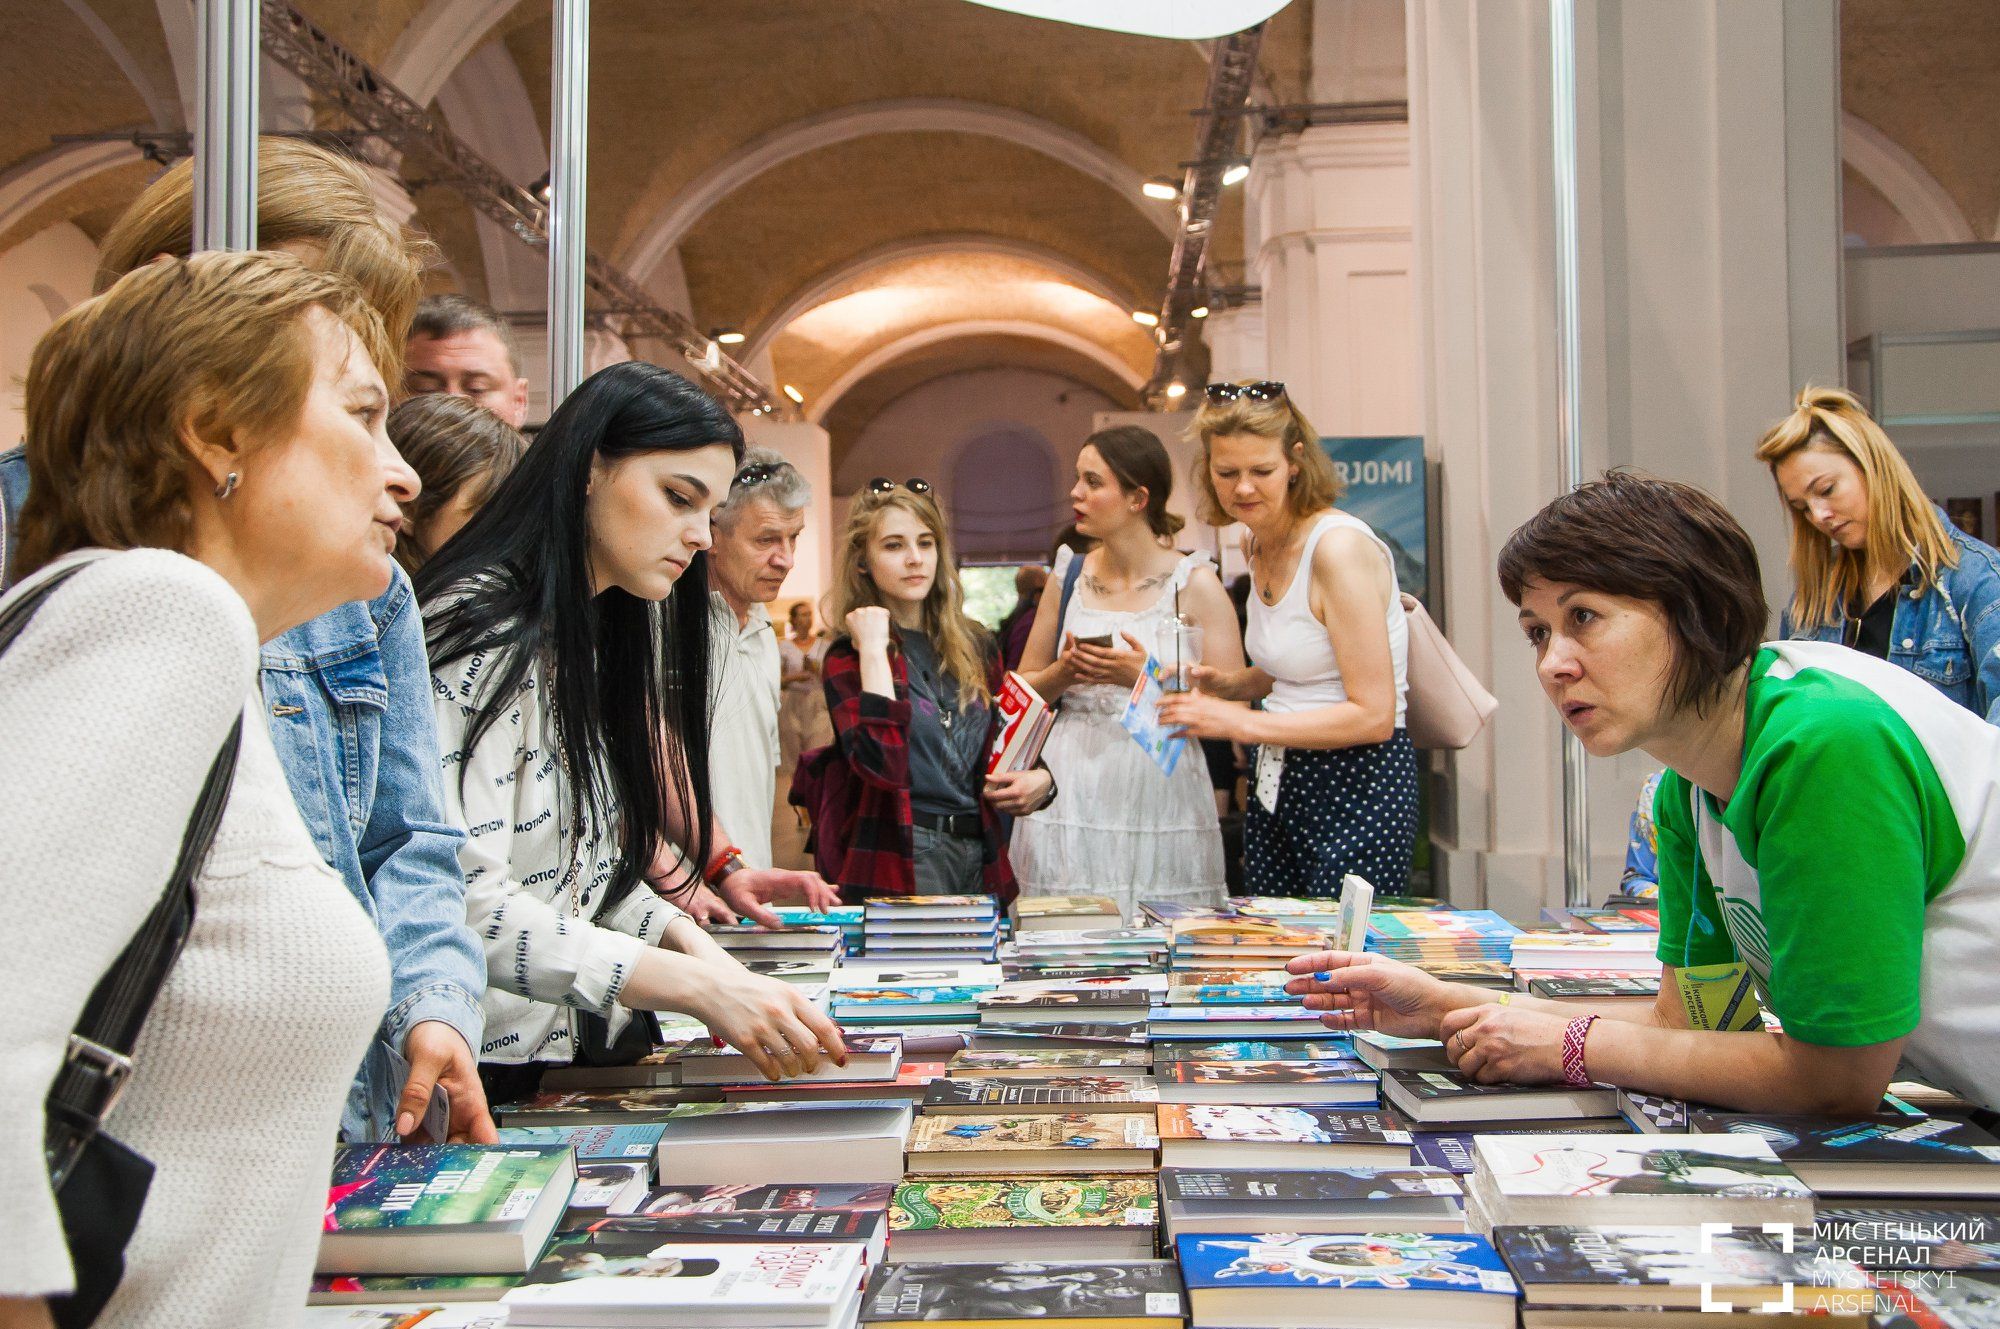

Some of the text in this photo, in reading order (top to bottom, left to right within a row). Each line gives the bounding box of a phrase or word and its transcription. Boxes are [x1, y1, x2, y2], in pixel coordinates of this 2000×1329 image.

[1333, 460, 1413, 484] RJOMI
[431, 673, 456, 701] OTION
[460, 680, 472, 697] IN
[511, 709, 520, 725] IN
[513, 808, 551, 834] MOTION
[521, 867, 559, 888] MOTIO
[1683, 989, 1700, 1025] АРСЕНАЛ
